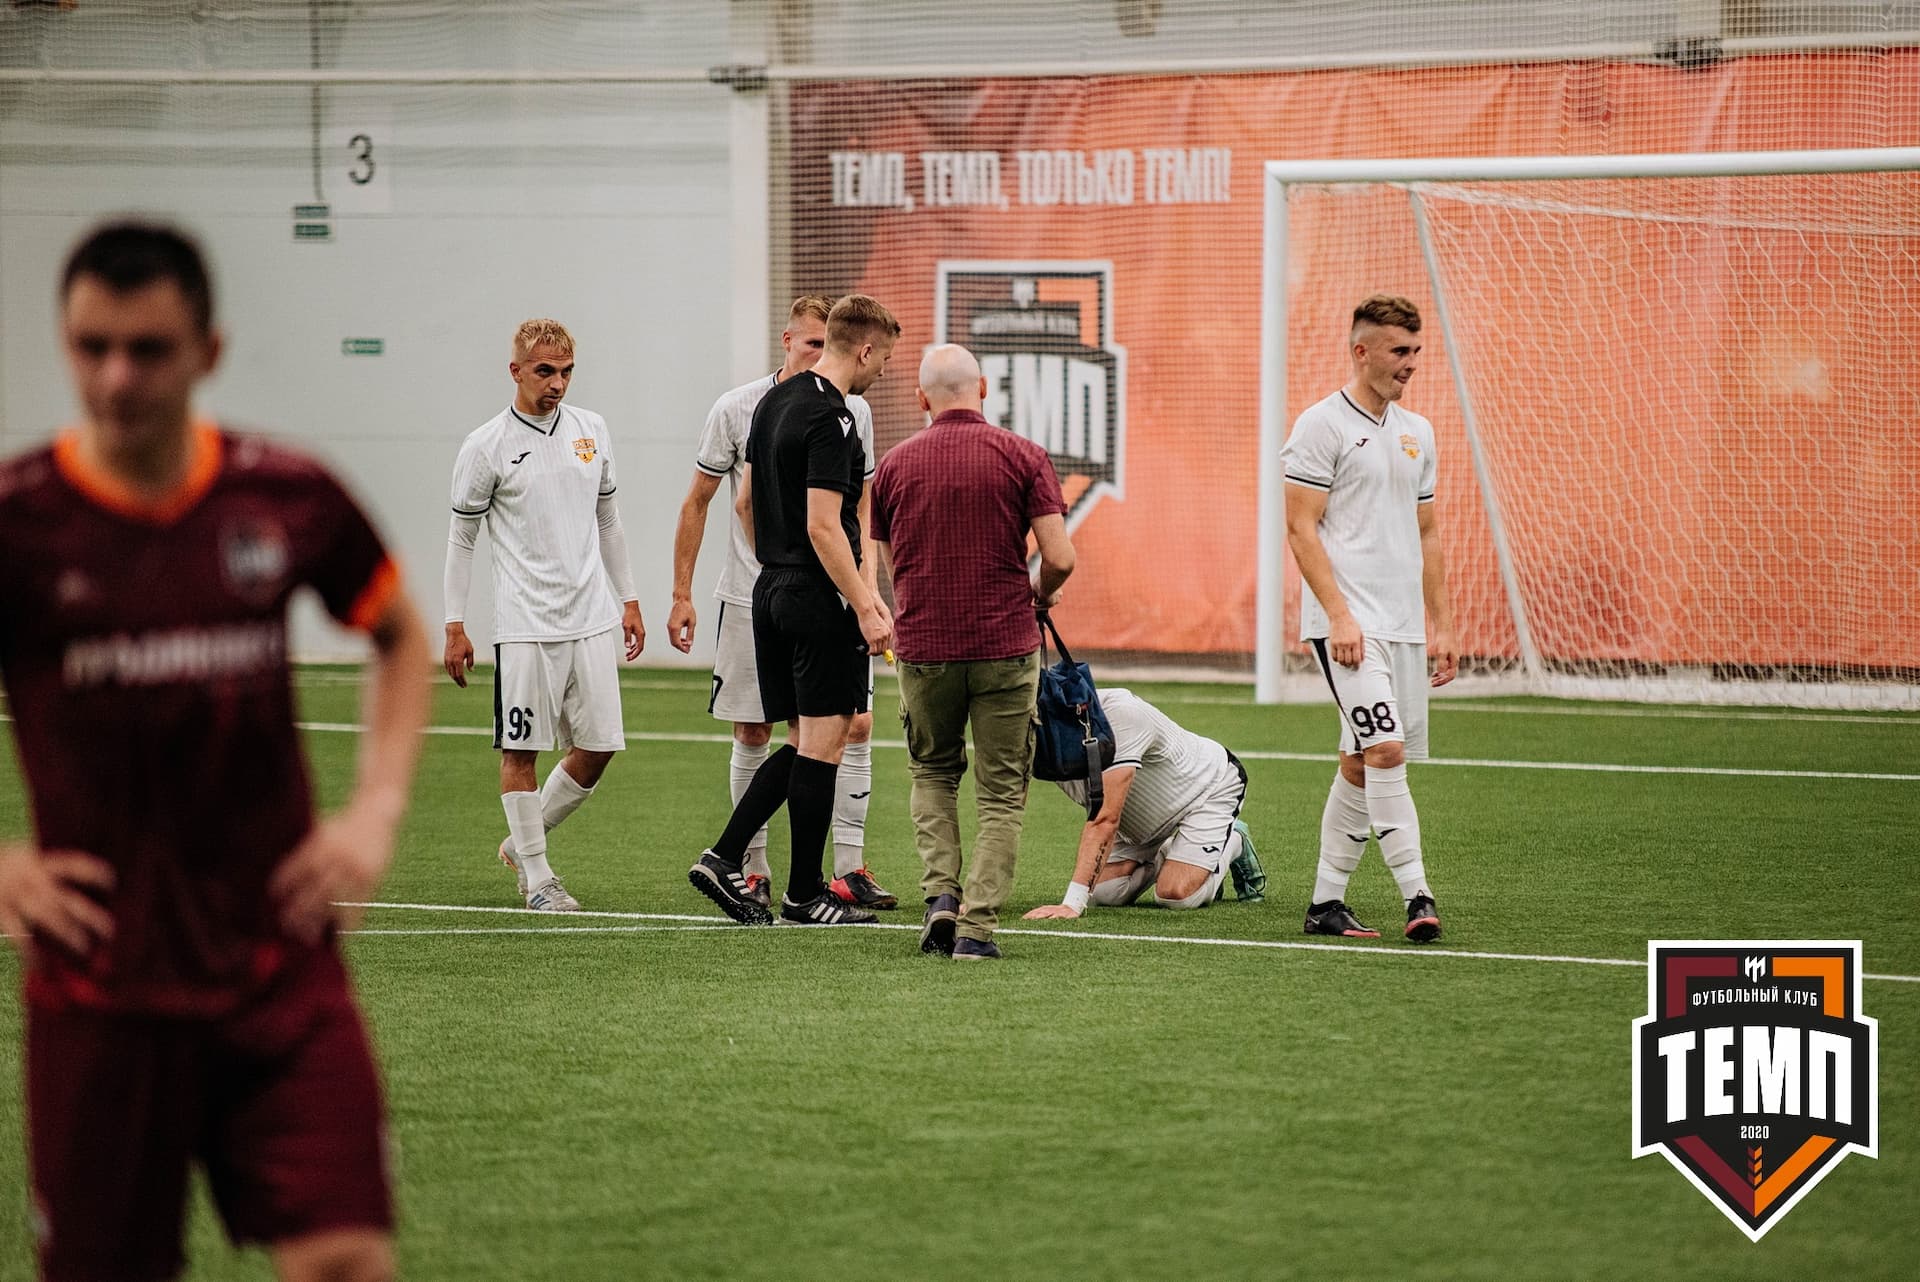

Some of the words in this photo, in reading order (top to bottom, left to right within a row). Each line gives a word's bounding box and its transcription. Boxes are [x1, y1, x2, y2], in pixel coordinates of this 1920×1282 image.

[348, 134, 375, 185] 3
[830, 151, 914, 212] ТЕМП,
[922, 151, 1009, 211] ТЕМП,
[1017, 150, 1135, 205] ТОЛЬКО
[1143, 148, 1231, 204] ТЕМП!
[980, 353, 1107, 465] ЕМП
[1351, 702, 1395, 738] 98
